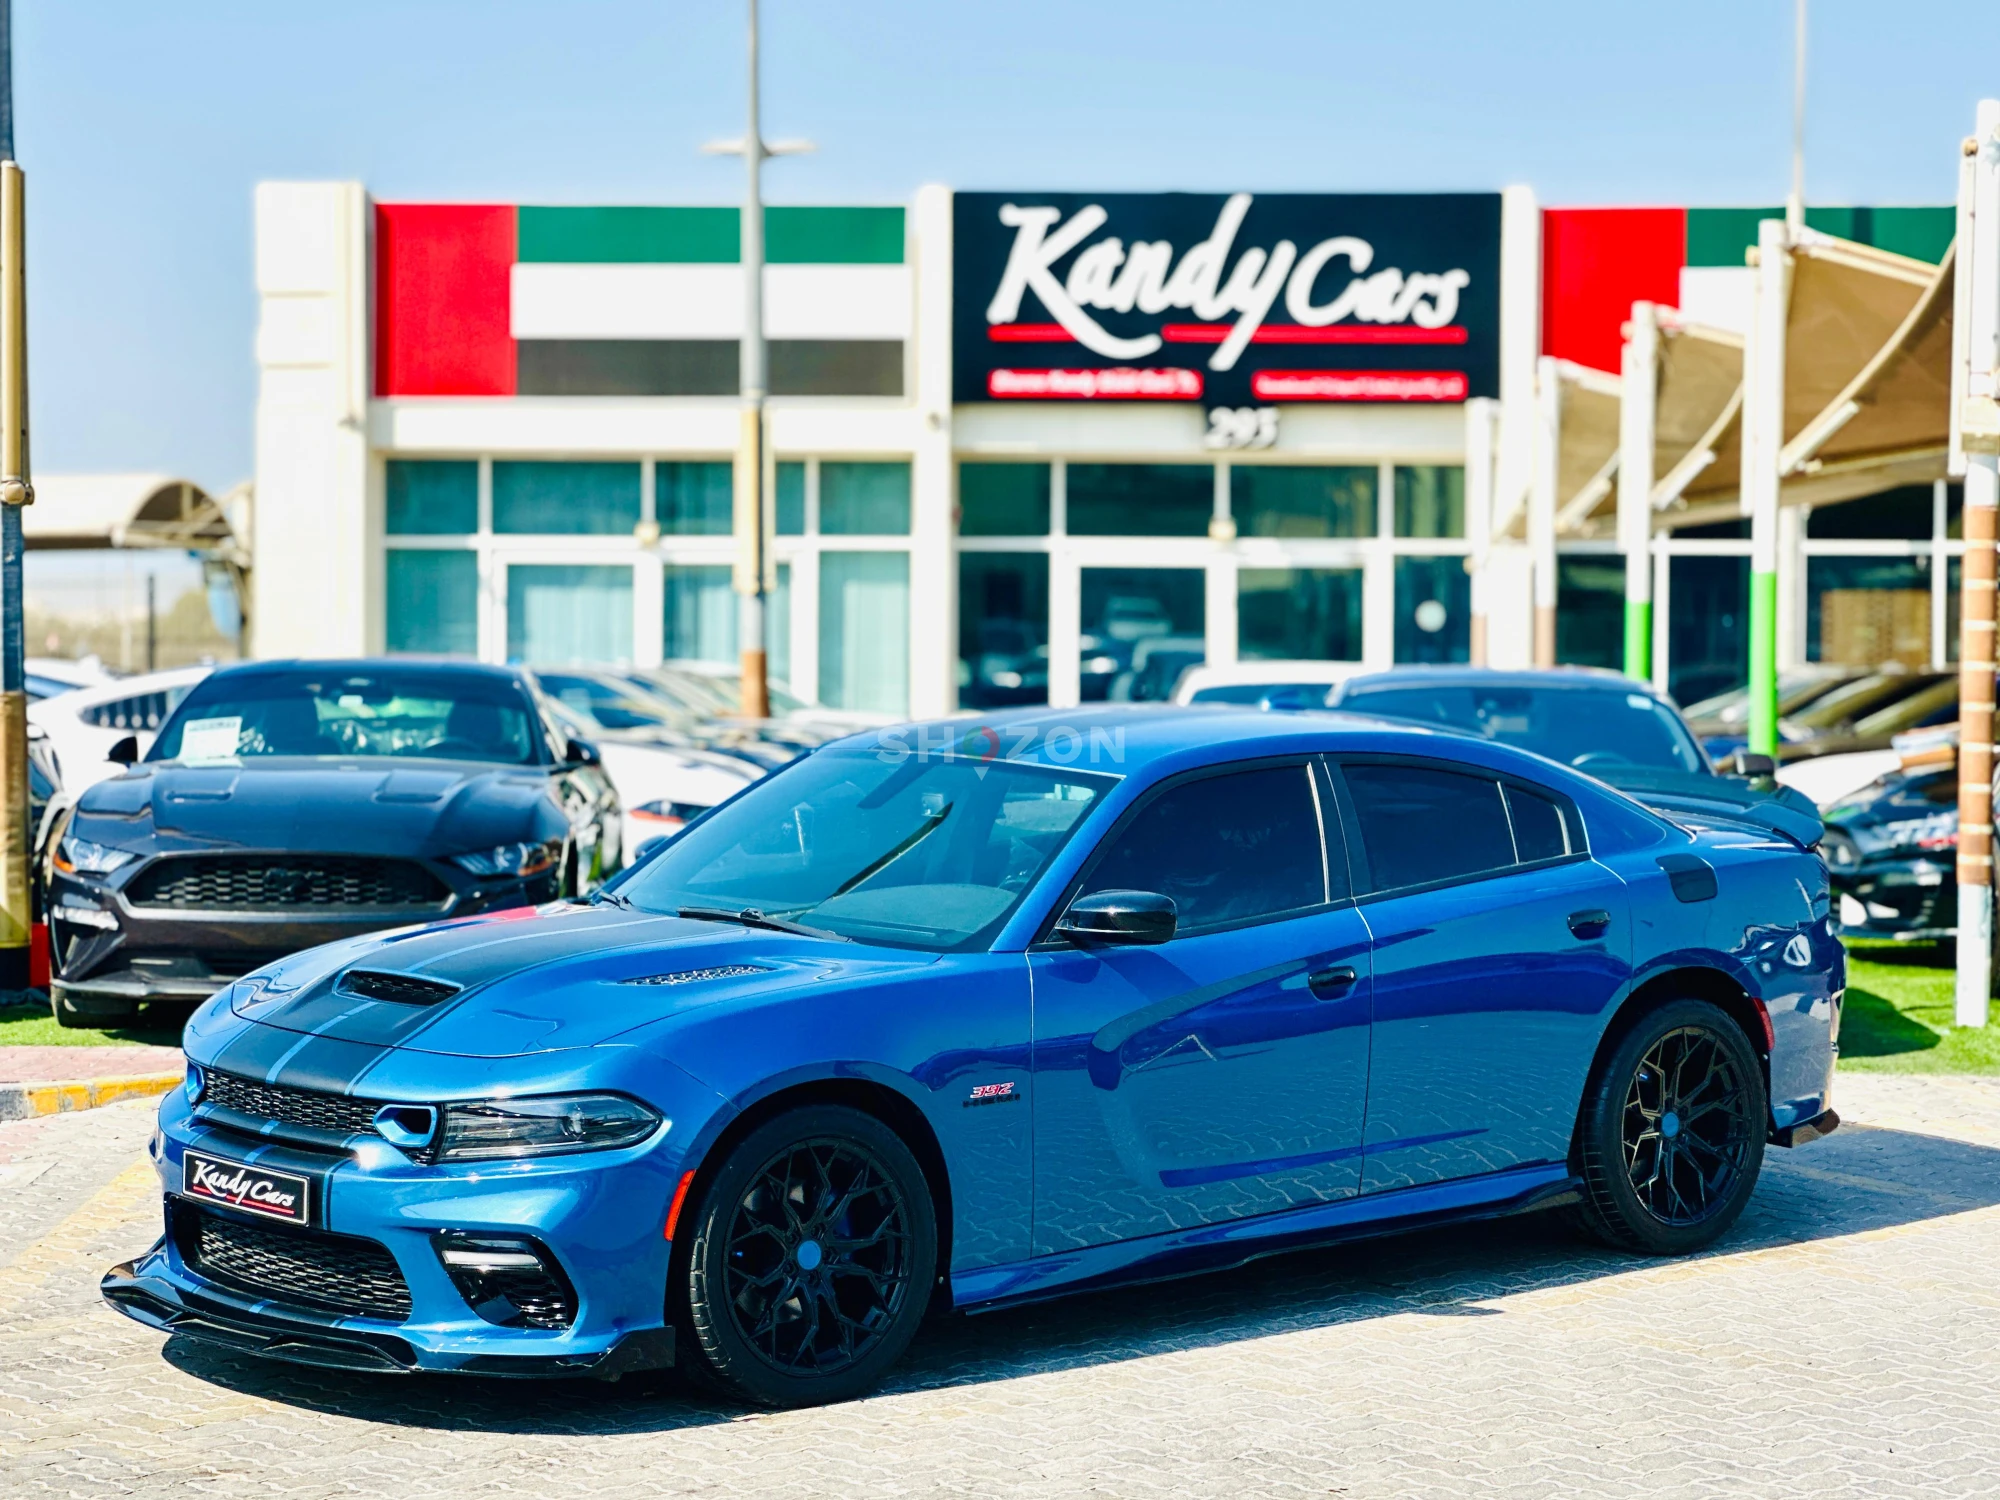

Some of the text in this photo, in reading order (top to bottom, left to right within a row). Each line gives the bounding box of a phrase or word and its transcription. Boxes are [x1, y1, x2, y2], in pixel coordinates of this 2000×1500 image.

[986, 193, 1471, 371] Kandy Cars
[970, 1081, 1015, 1099] 392
[192, 1159, 296, 1207] Kandy Cars
